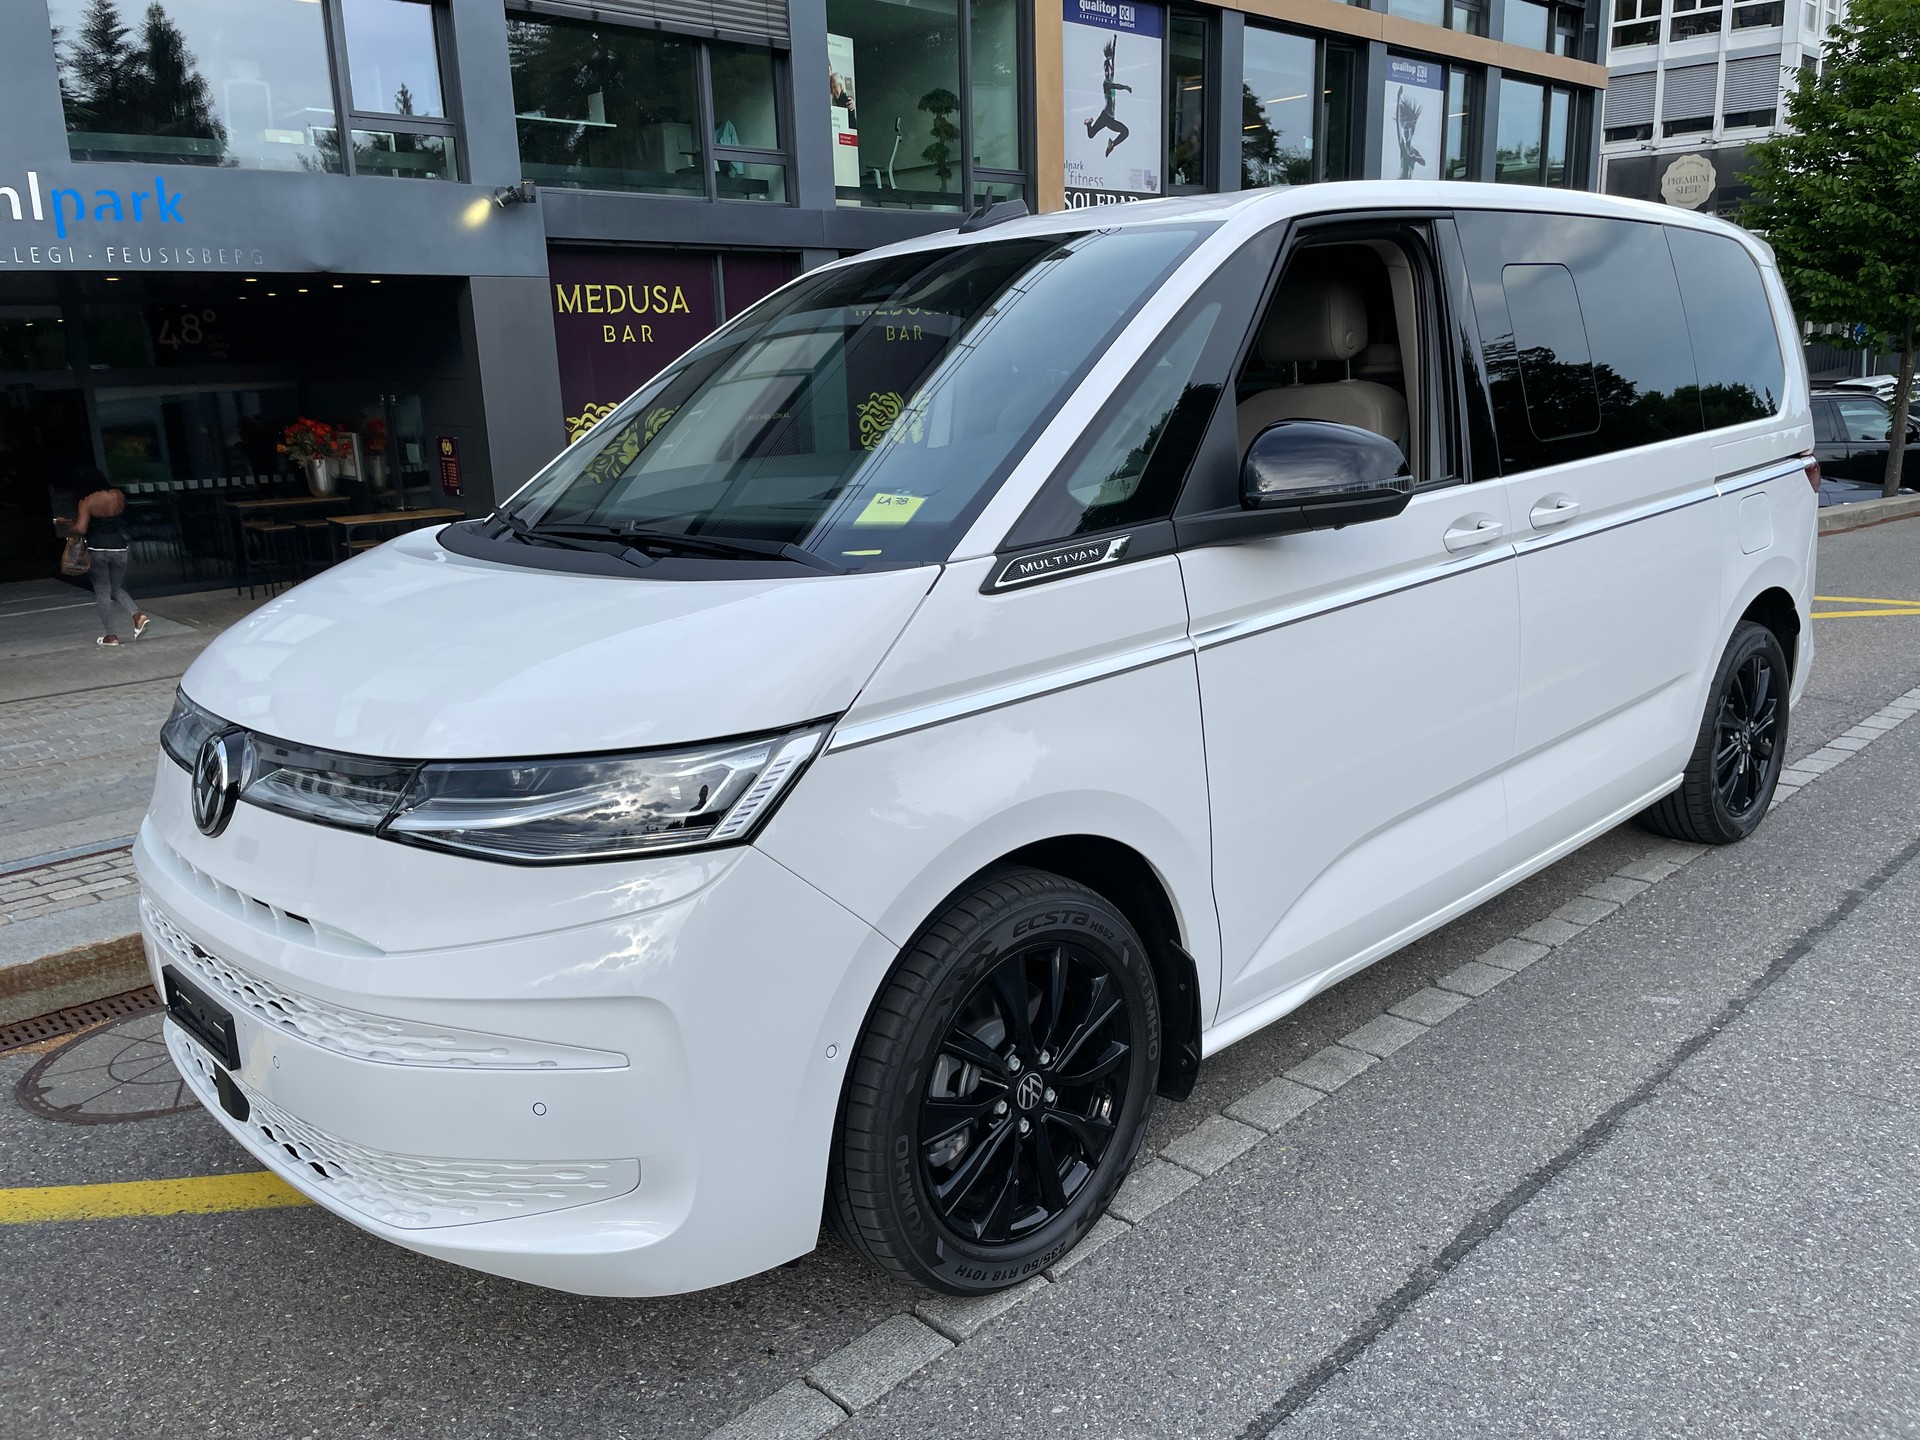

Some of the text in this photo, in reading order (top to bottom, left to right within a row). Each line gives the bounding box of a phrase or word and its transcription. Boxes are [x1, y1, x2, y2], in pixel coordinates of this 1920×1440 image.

[1079, 0, 1117, 17] qualitop
[1064, 160, 1084, 172] lpark
[1069, 171, 1104, 187] fitness
[1667, 174, 1710, 186] PREMIUM
[555, 284, 691, 315] MEDUSA
[603, 324, 654, 343] BAR
[886, 325, 923, 341] BAR
[1020, 548, 1099, 574] MULTIVAN
[954, 1240, 1067, 1281] 235/50 R18 101H
